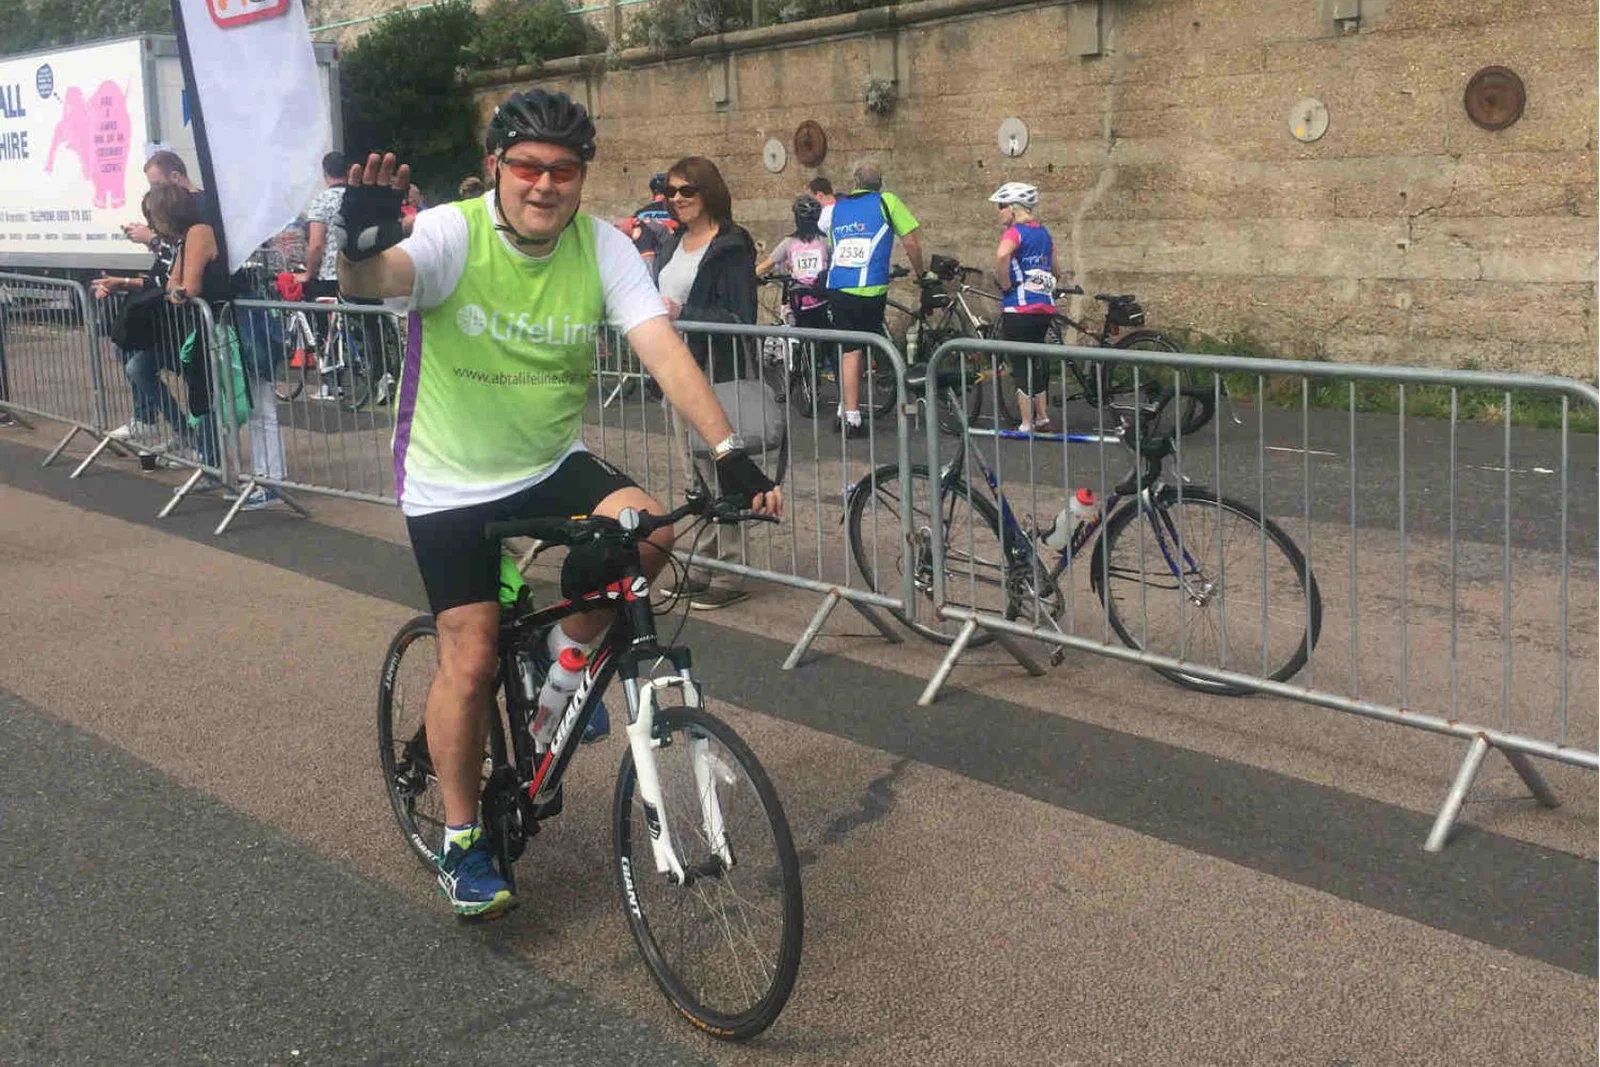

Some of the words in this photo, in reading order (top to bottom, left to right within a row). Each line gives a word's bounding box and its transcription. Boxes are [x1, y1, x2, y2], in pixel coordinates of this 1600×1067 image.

[839, 246, 865, 258] 2536
[798, 257, 818, 270] 1377
[621, 856, 641, 919] GIANT
